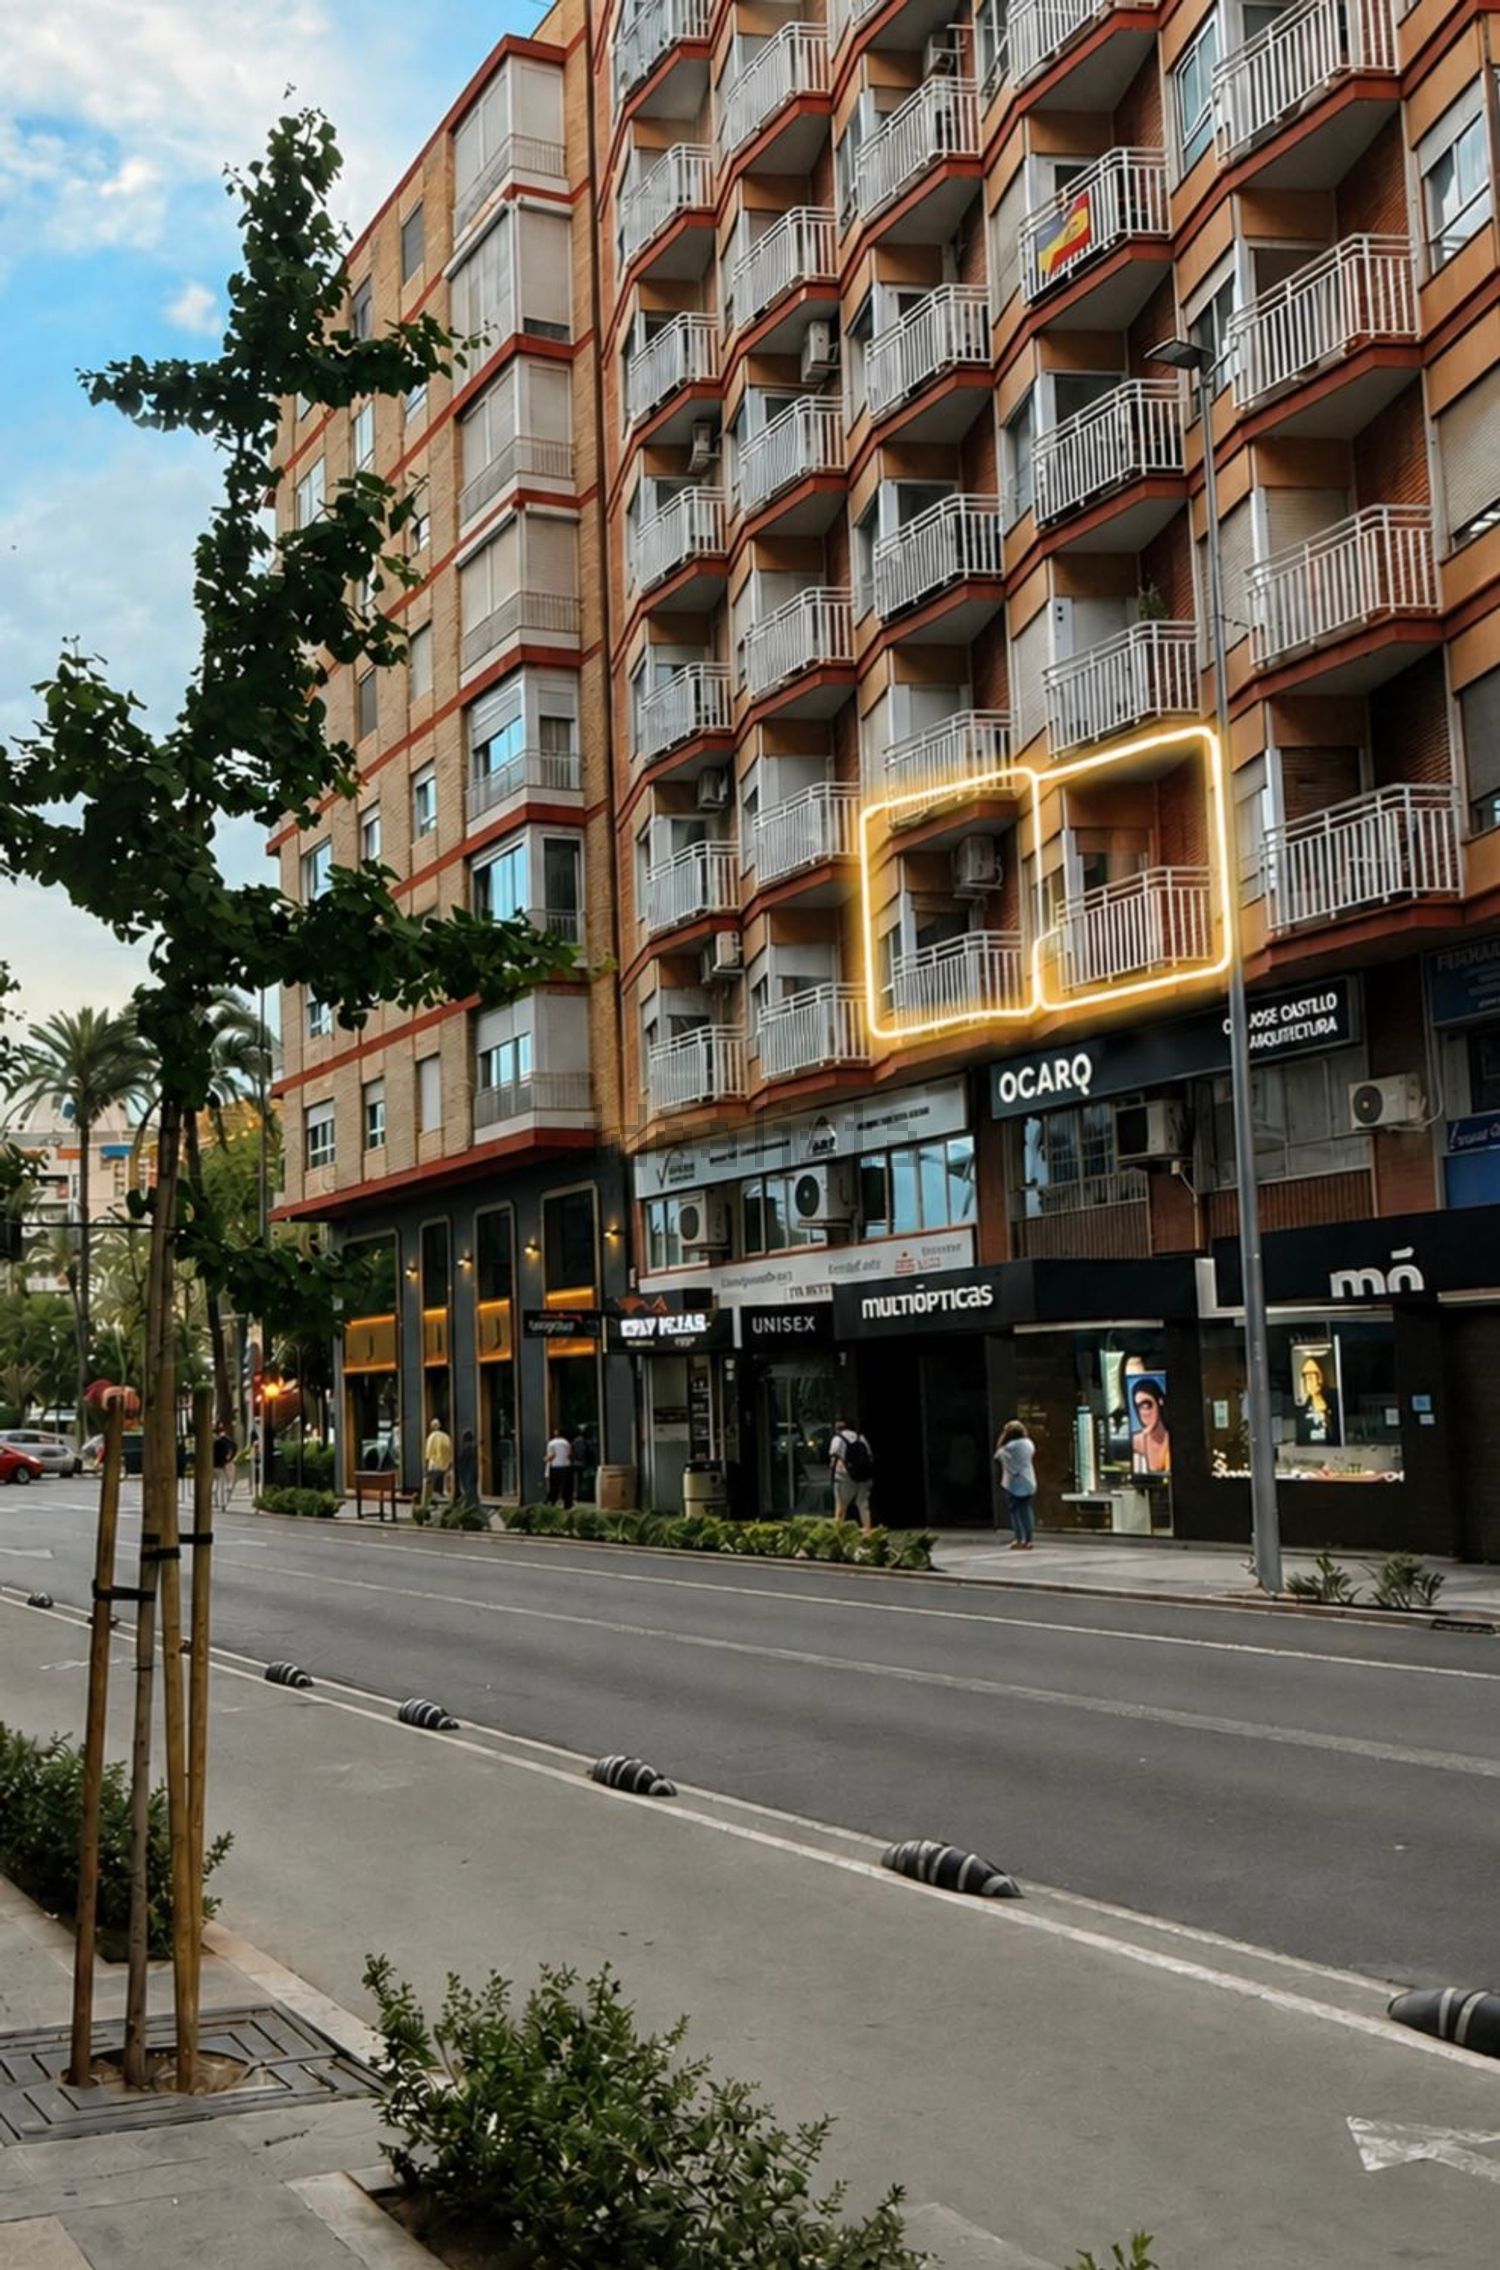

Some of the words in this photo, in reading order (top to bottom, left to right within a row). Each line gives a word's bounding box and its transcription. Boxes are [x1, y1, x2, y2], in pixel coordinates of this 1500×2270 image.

[1249, 1006, 1278, 1029] JOSE
[999, 1052, 1092, 1103] OCARQ
[752, 1315, 816, 1335] UNISEX
